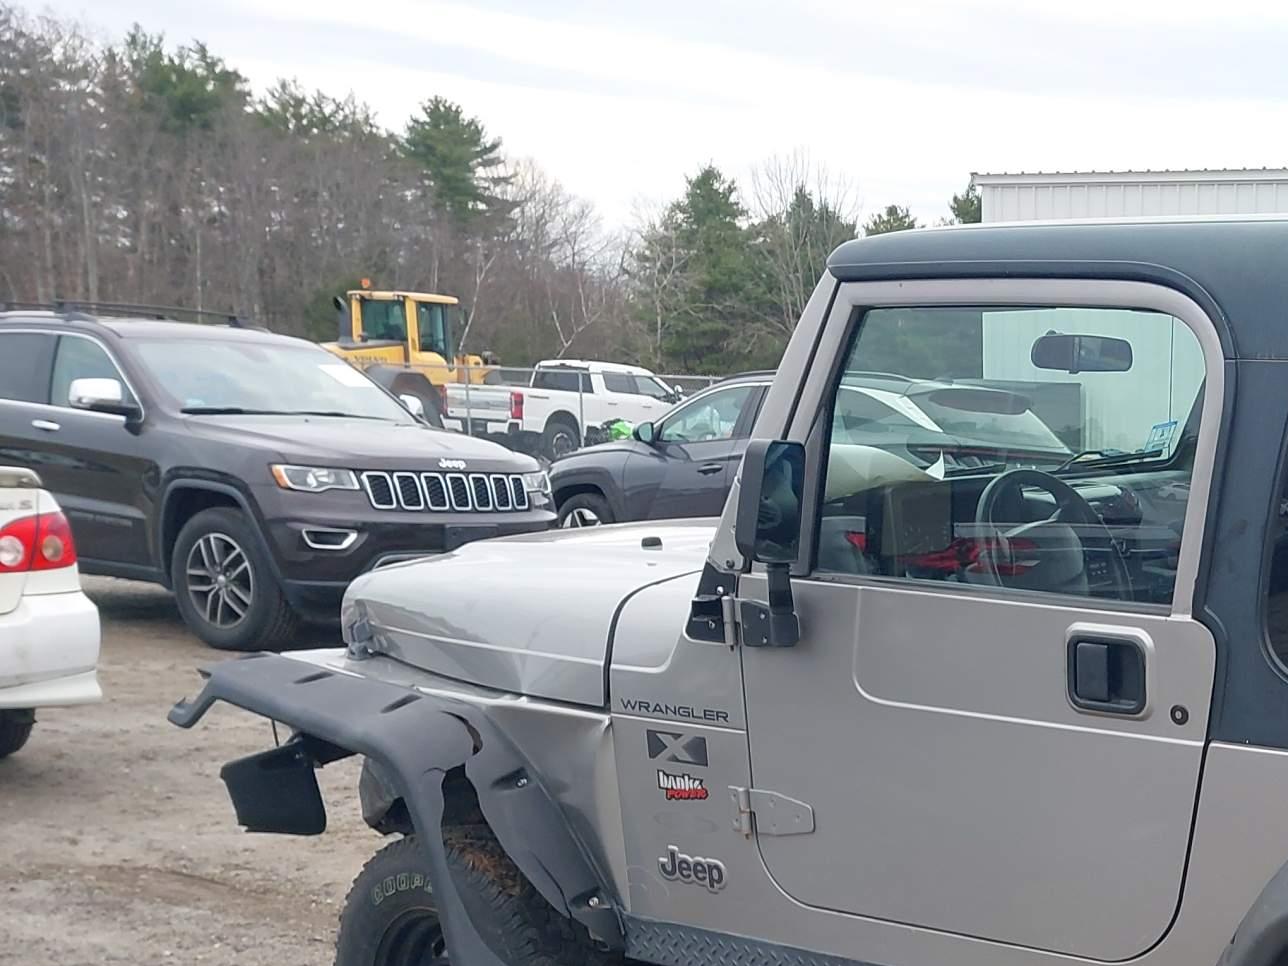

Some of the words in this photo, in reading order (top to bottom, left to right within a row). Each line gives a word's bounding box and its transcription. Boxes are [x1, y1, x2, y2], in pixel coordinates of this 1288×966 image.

[438, 457, 466, 470] Jeep
[620, 698, 729, 723] WRANGLER
[659, 845, 727, 893] Jeep
